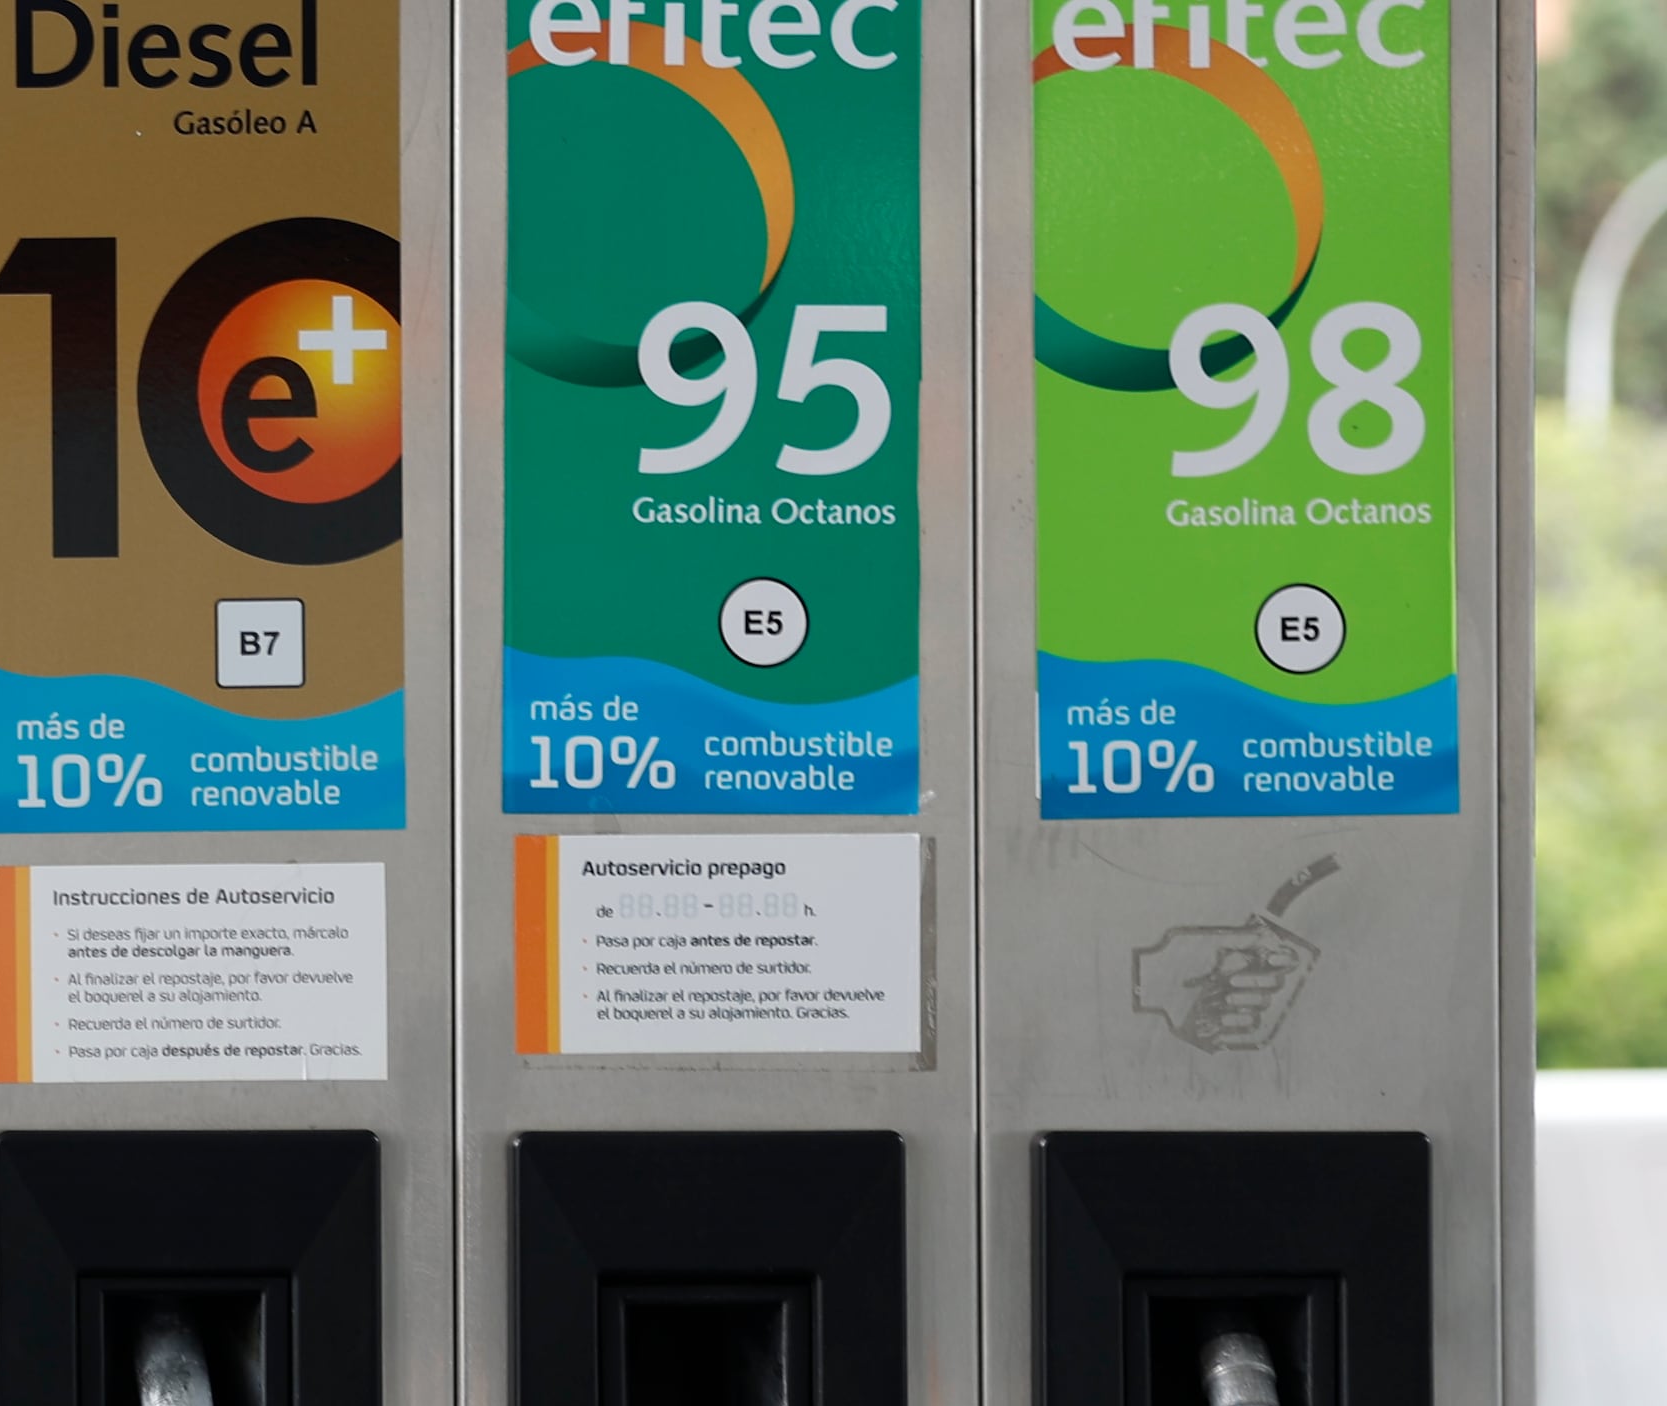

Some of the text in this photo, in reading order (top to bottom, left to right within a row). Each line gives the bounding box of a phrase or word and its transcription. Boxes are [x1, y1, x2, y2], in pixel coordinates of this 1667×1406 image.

[14, 0, 318, 89] Diesel
[173, 108, 318, 136] Gasóleo A
[638, 300, 892, 476] 95
[1168, 301, 1426, 478] 98
[632, 495, 896, 525] Gasolina Octanos
[1165, 497, 1432, 527] Gasolina Octanos
[744, 609, 784, 636] E5
[1280, 616, 1320, 642] E5
[239, 631, 281, 657] B7
[530, 692, 639, 722] más de
[1066, 697, 1176, 726] más de
[16, 711, 125, 741] más de
[704, 730, 893, 757] combustible
[1243, 730, 1433, 759] combustible
[190, 744, 378, 773] combustible
[530, 735, 676, 789] 10%
[1068, 739, 1214, 794] 10%
[17, 753, 163, 808] 10%
[705, 764, 855, 791] renovable
[1243, 764, 1394, 792] renovable
[191, 778, 341, 807] renovable
[581, 859, 786, 880] Autoservicio prepago
[53, 887, 335, 906] Instrucciones de Autoservicio
[596, 904, 614, 918] de
[66, 925, 349, 942] Si deseas fijar un importe exacto, márcalo
[596, 933, 818, 950] Pasa por caja antes de repostar.
[67, 943, 292, 960] antes de descolgar la manguera.
[67, 970, 354, 988] Al finalizar el repostaje, por favor devuelve
[596, 960, 812, 976] Recuerda el número de surtidor.
[67, 988, 262, 1005] el boquerel a su alojamiento.
[596, 988, 886, 1004] Al finalizar el repostaje, por favor devuelve
[68, 1015, 282, 1031] Recuerda el número de surtidor.
[596, 1006, 850, 1023] el boquerel a su alojamiento. Gracias.
[68, 1043, 361, 1060] Pasa por caja después de repostar. Gracias.
